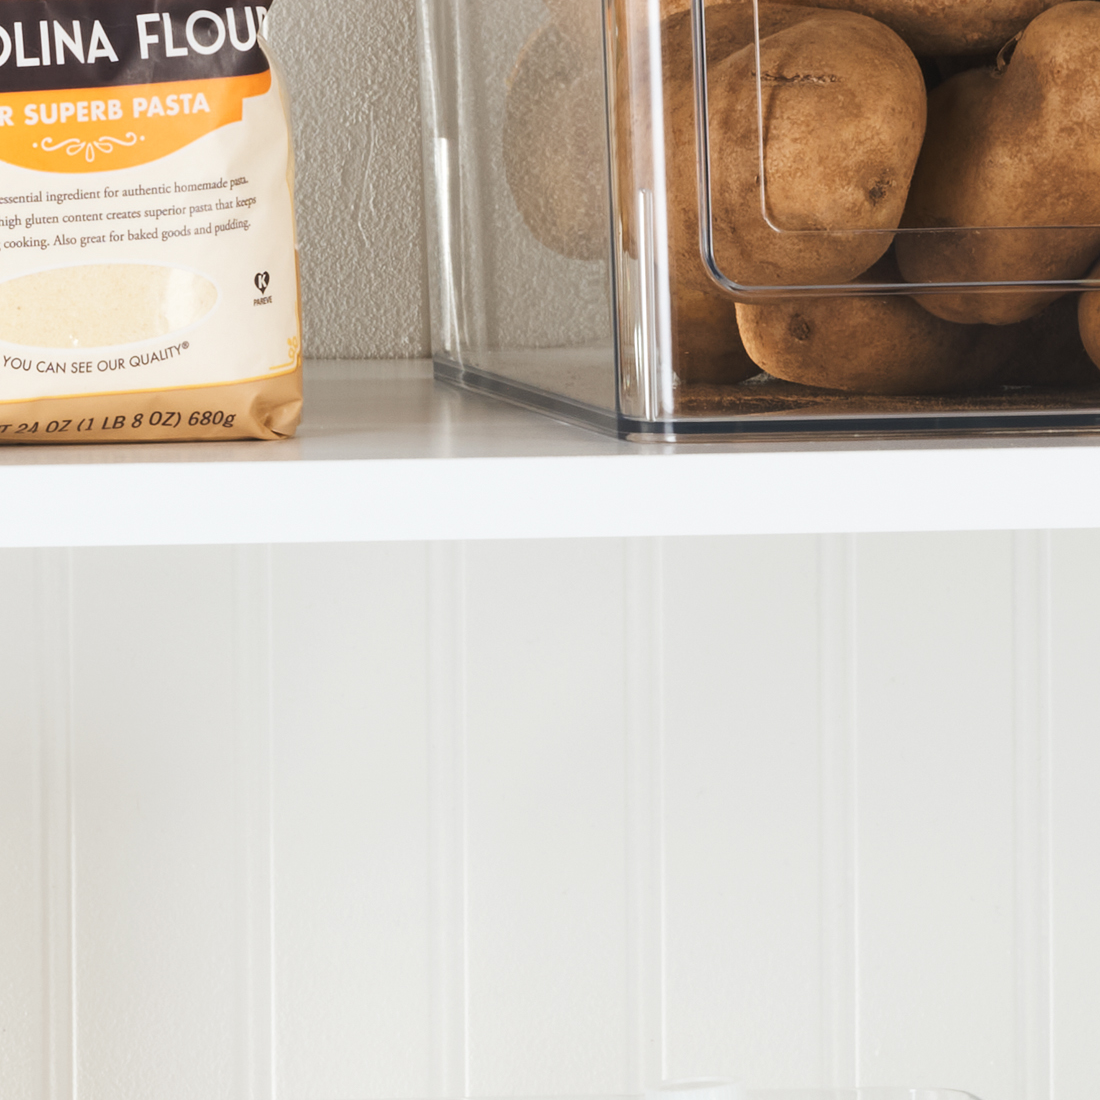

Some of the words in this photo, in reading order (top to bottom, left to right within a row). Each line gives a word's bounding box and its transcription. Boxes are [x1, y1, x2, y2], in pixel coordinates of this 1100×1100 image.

[24, 97, 124, 126] SUPERB
[132, 92, 211, 118] PASTA
[46, 188, 101, 205] ingredient
[103, 186, 119, 198] for
[122, 183, 172, 197] authentic
[174, 177, 228, 193] homemade
[230, 176, 249, 190] pasta.
[25, 213, 59, 229] gluten
[62, 211, 103, 223] content
[106, 208, 141, 221] creates
[144, 205, 187, 220] superior
[189, 203, 213, 217] pasta
[215, 198, 233, 211] that
[235, 196, 257, 208] keeps
[3, 236, 50, 250] cooking.
[53, 234, 77, 246] Also
[80, 234, 106, 248] great
[109, 230, 125, 242] for
[127, 227, 158, 240] baked
[161, 225, 191, 242] goods
[194, 222, 212, 235] and
[214, 219, 251, 236] pudding.
[3, 355, 32, 371] YOU
[36, 361, 66, 374] CAN
[70, 361, 93, 374] SEE
[97, 358, 126, 372] OUR
[14, 421, 39, 434] 24
[45, 419, 73, 433] OZ
[77, 417, 95, 432] (1
[102, 415, 126, 430] LB
[131, 413, 144, 428] 8
[149, 411, 182, 428] OZ)
[188, 409, 237, 428] 680g
